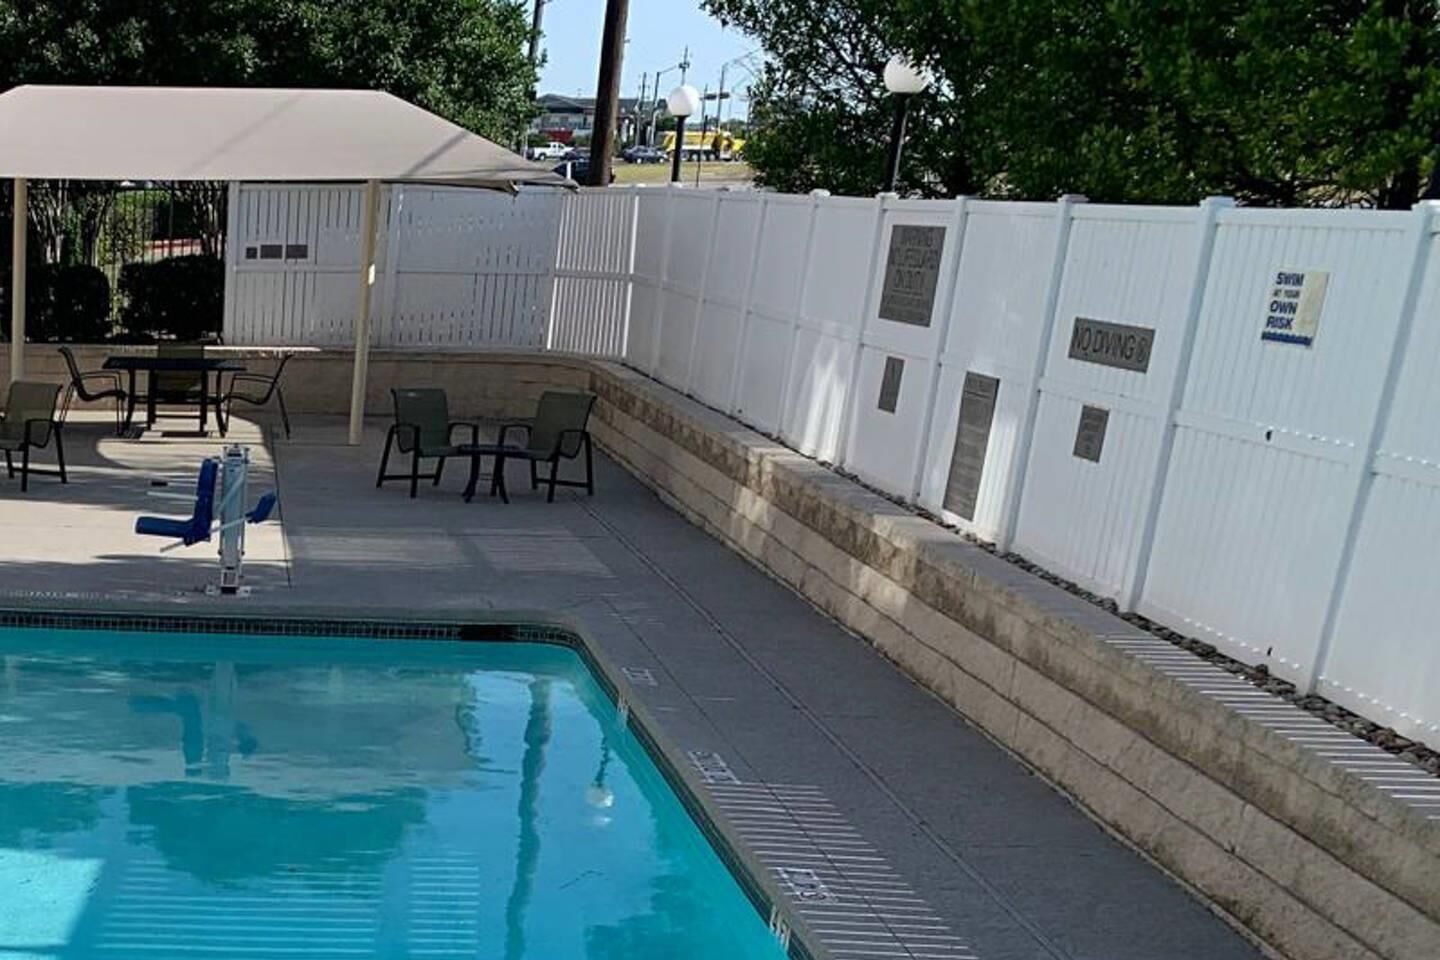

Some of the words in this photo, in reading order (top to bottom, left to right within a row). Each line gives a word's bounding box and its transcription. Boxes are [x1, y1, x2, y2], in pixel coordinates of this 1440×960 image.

[1276, 272, 1304, 287] SWIM
[1270, 300, 1298, 314] OWN
[1266, 315, 1293, 330] RISK
